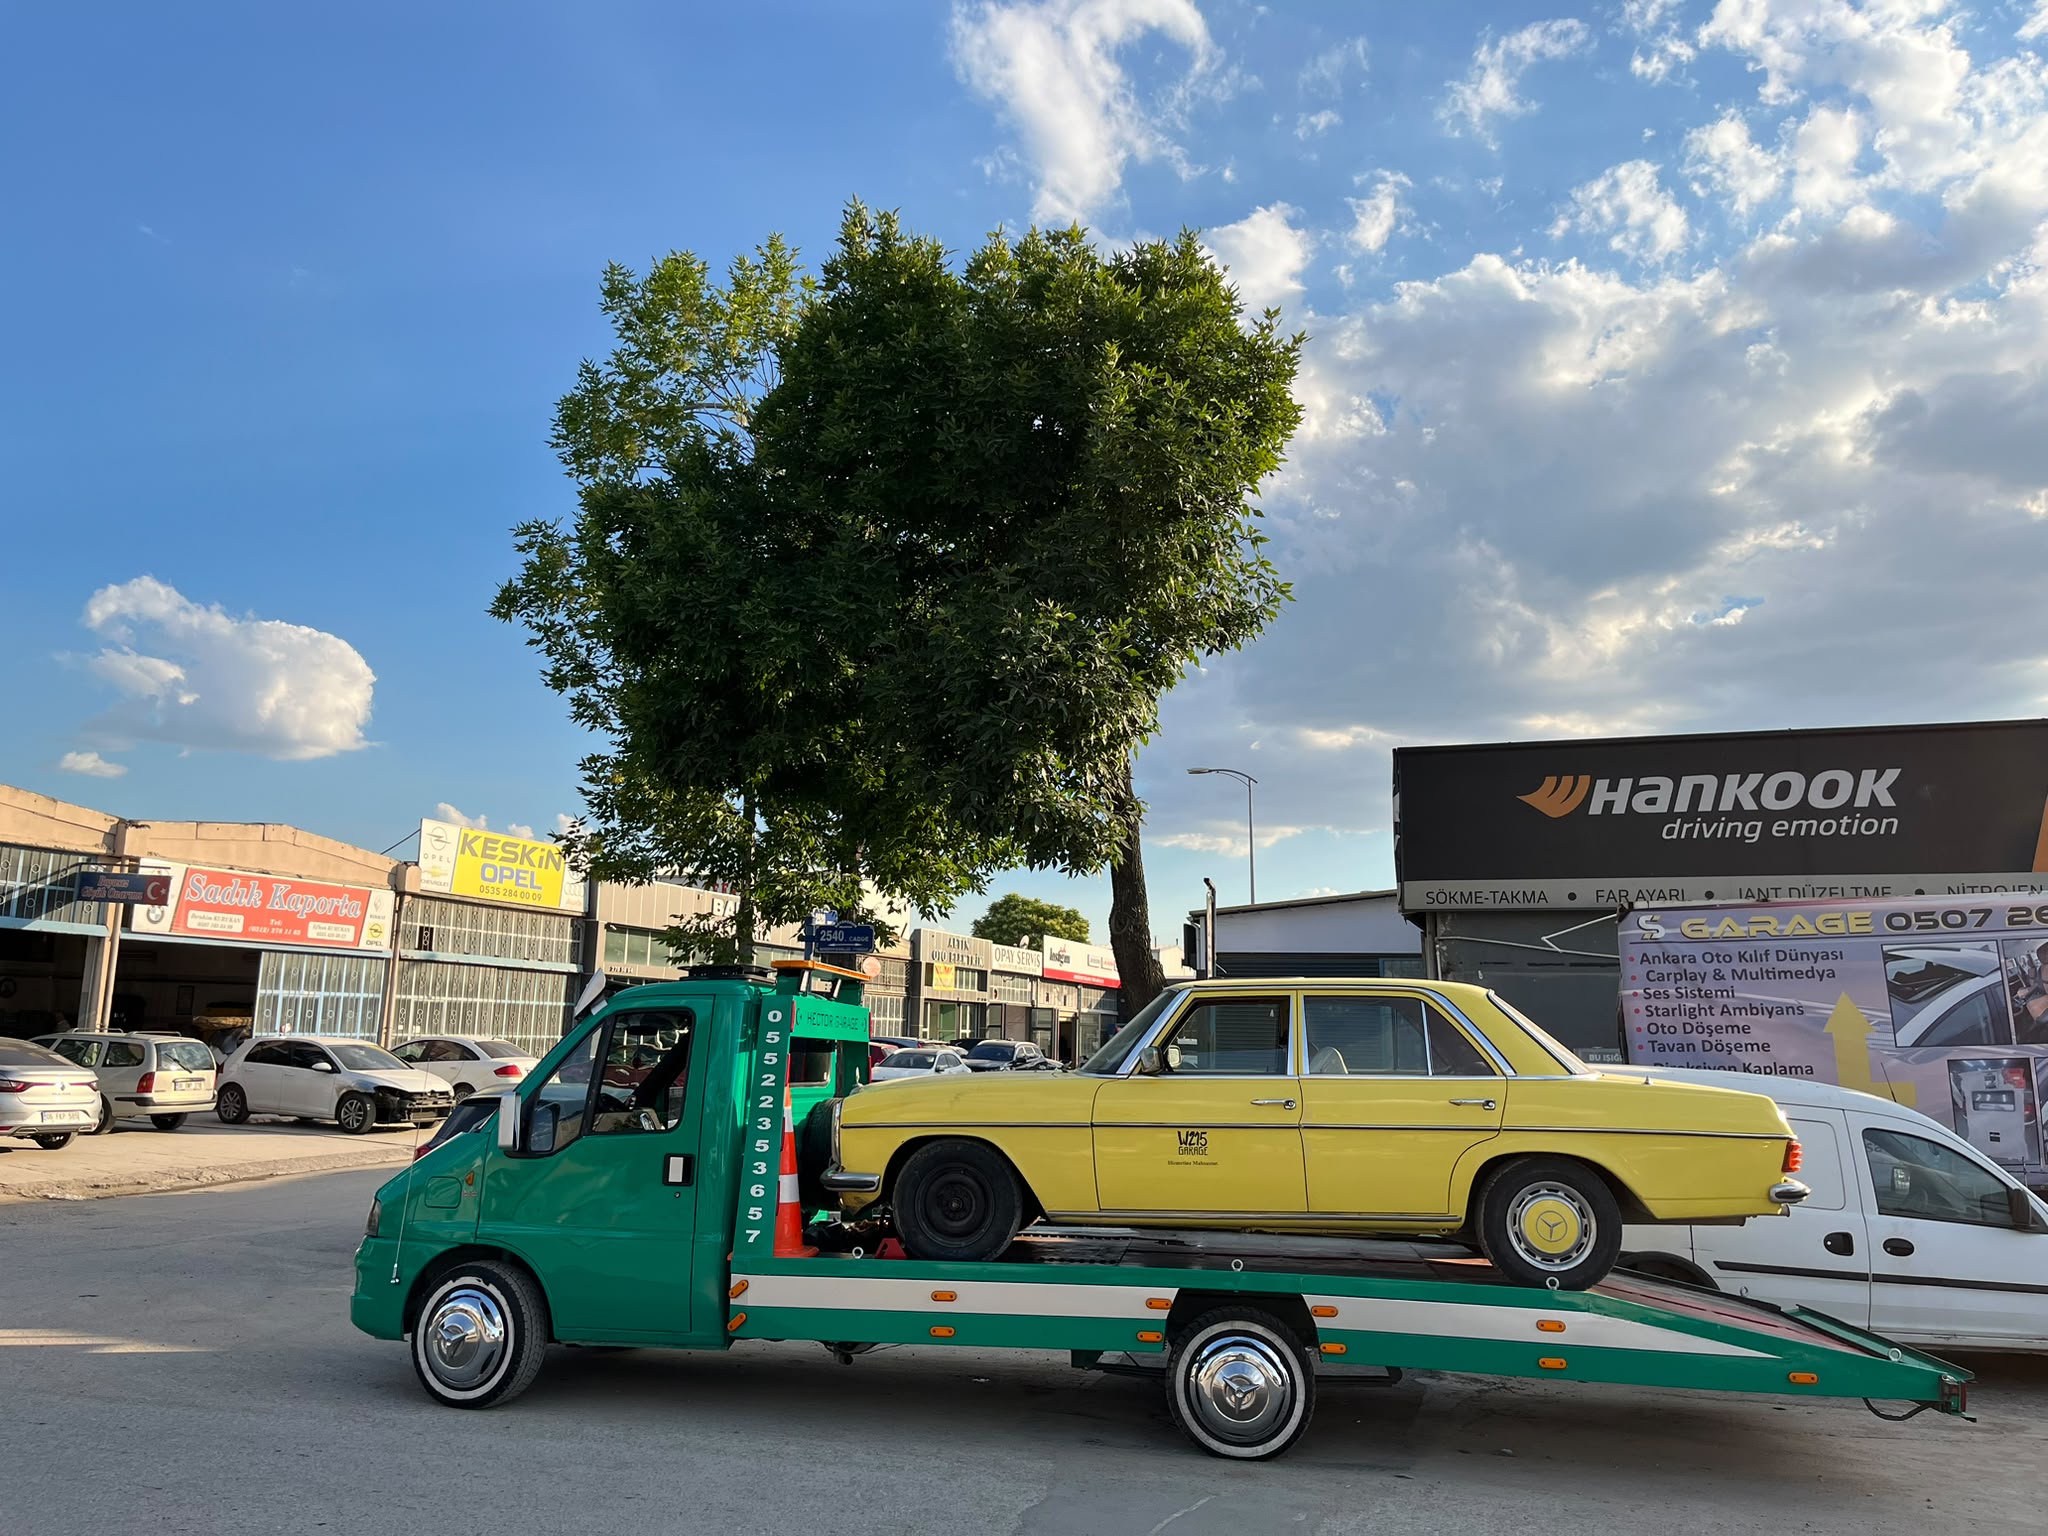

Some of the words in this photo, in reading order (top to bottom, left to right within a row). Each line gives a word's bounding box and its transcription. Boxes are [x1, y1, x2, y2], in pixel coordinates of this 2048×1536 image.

[1662, 816, 1761, 843] driving
[1771, 815, 1899, 838] emotion
[423, 853, 451, 863] OPEL
[480, 862, 543, 890] OPEL
[185, 873, 262, 908] Sadık
[268, 883, 362, 919] Kaporta
[479, 885, 501, 896] 0535
[502, 887, 518, 898] 284
[519, 890, 531, 900] 00
[532, 892, 543, 902] 09
[1425, 886, 1549, 905] SÖKME-TAKMA
[1595, 889, 1629, 903] FAR
[1636, 888, 1685, 901] AYARI
[1680, 911, 1874, 939] GARAGE
[1884, 908, 1994, 933] 0507
[366, 940, 384, 948] OPEL
[994, 947, 1014, 964] OPAY
[1639, 951, 1697, 965] Ankara
[1702, 951, 1733, 964] Oto
[1738, 949, 1771, 963] Kılıf
[1775, 948, 1844, 965] Dünyası
[1645, 969, 1707, 984] Carplay
[1712, 969, 1726, 981] &
[1731, 966, 1836, 982] Multimedya
[1643, 987, 1670, 1000] Ses
[1675, 986, 1735, 999] Sistemi
[1645, 1003, 1715, 1019] Starlight
[1720, 1003, 1805, 1018] Ambiyans
[1647, 1022, 1678, 1035] Oto
[1682, 1022, 1751, 1037] Döşeme
[1648, 1040, 1696, 1053] Tavan
[1701, 1039, 1771, 1055] Döşeme
[1743, 1062, 1814, 1076] Kaplama
[1177, 1131, 1208, 1146] W215
[1178, 1147, 1208, 1155] GARAGE
